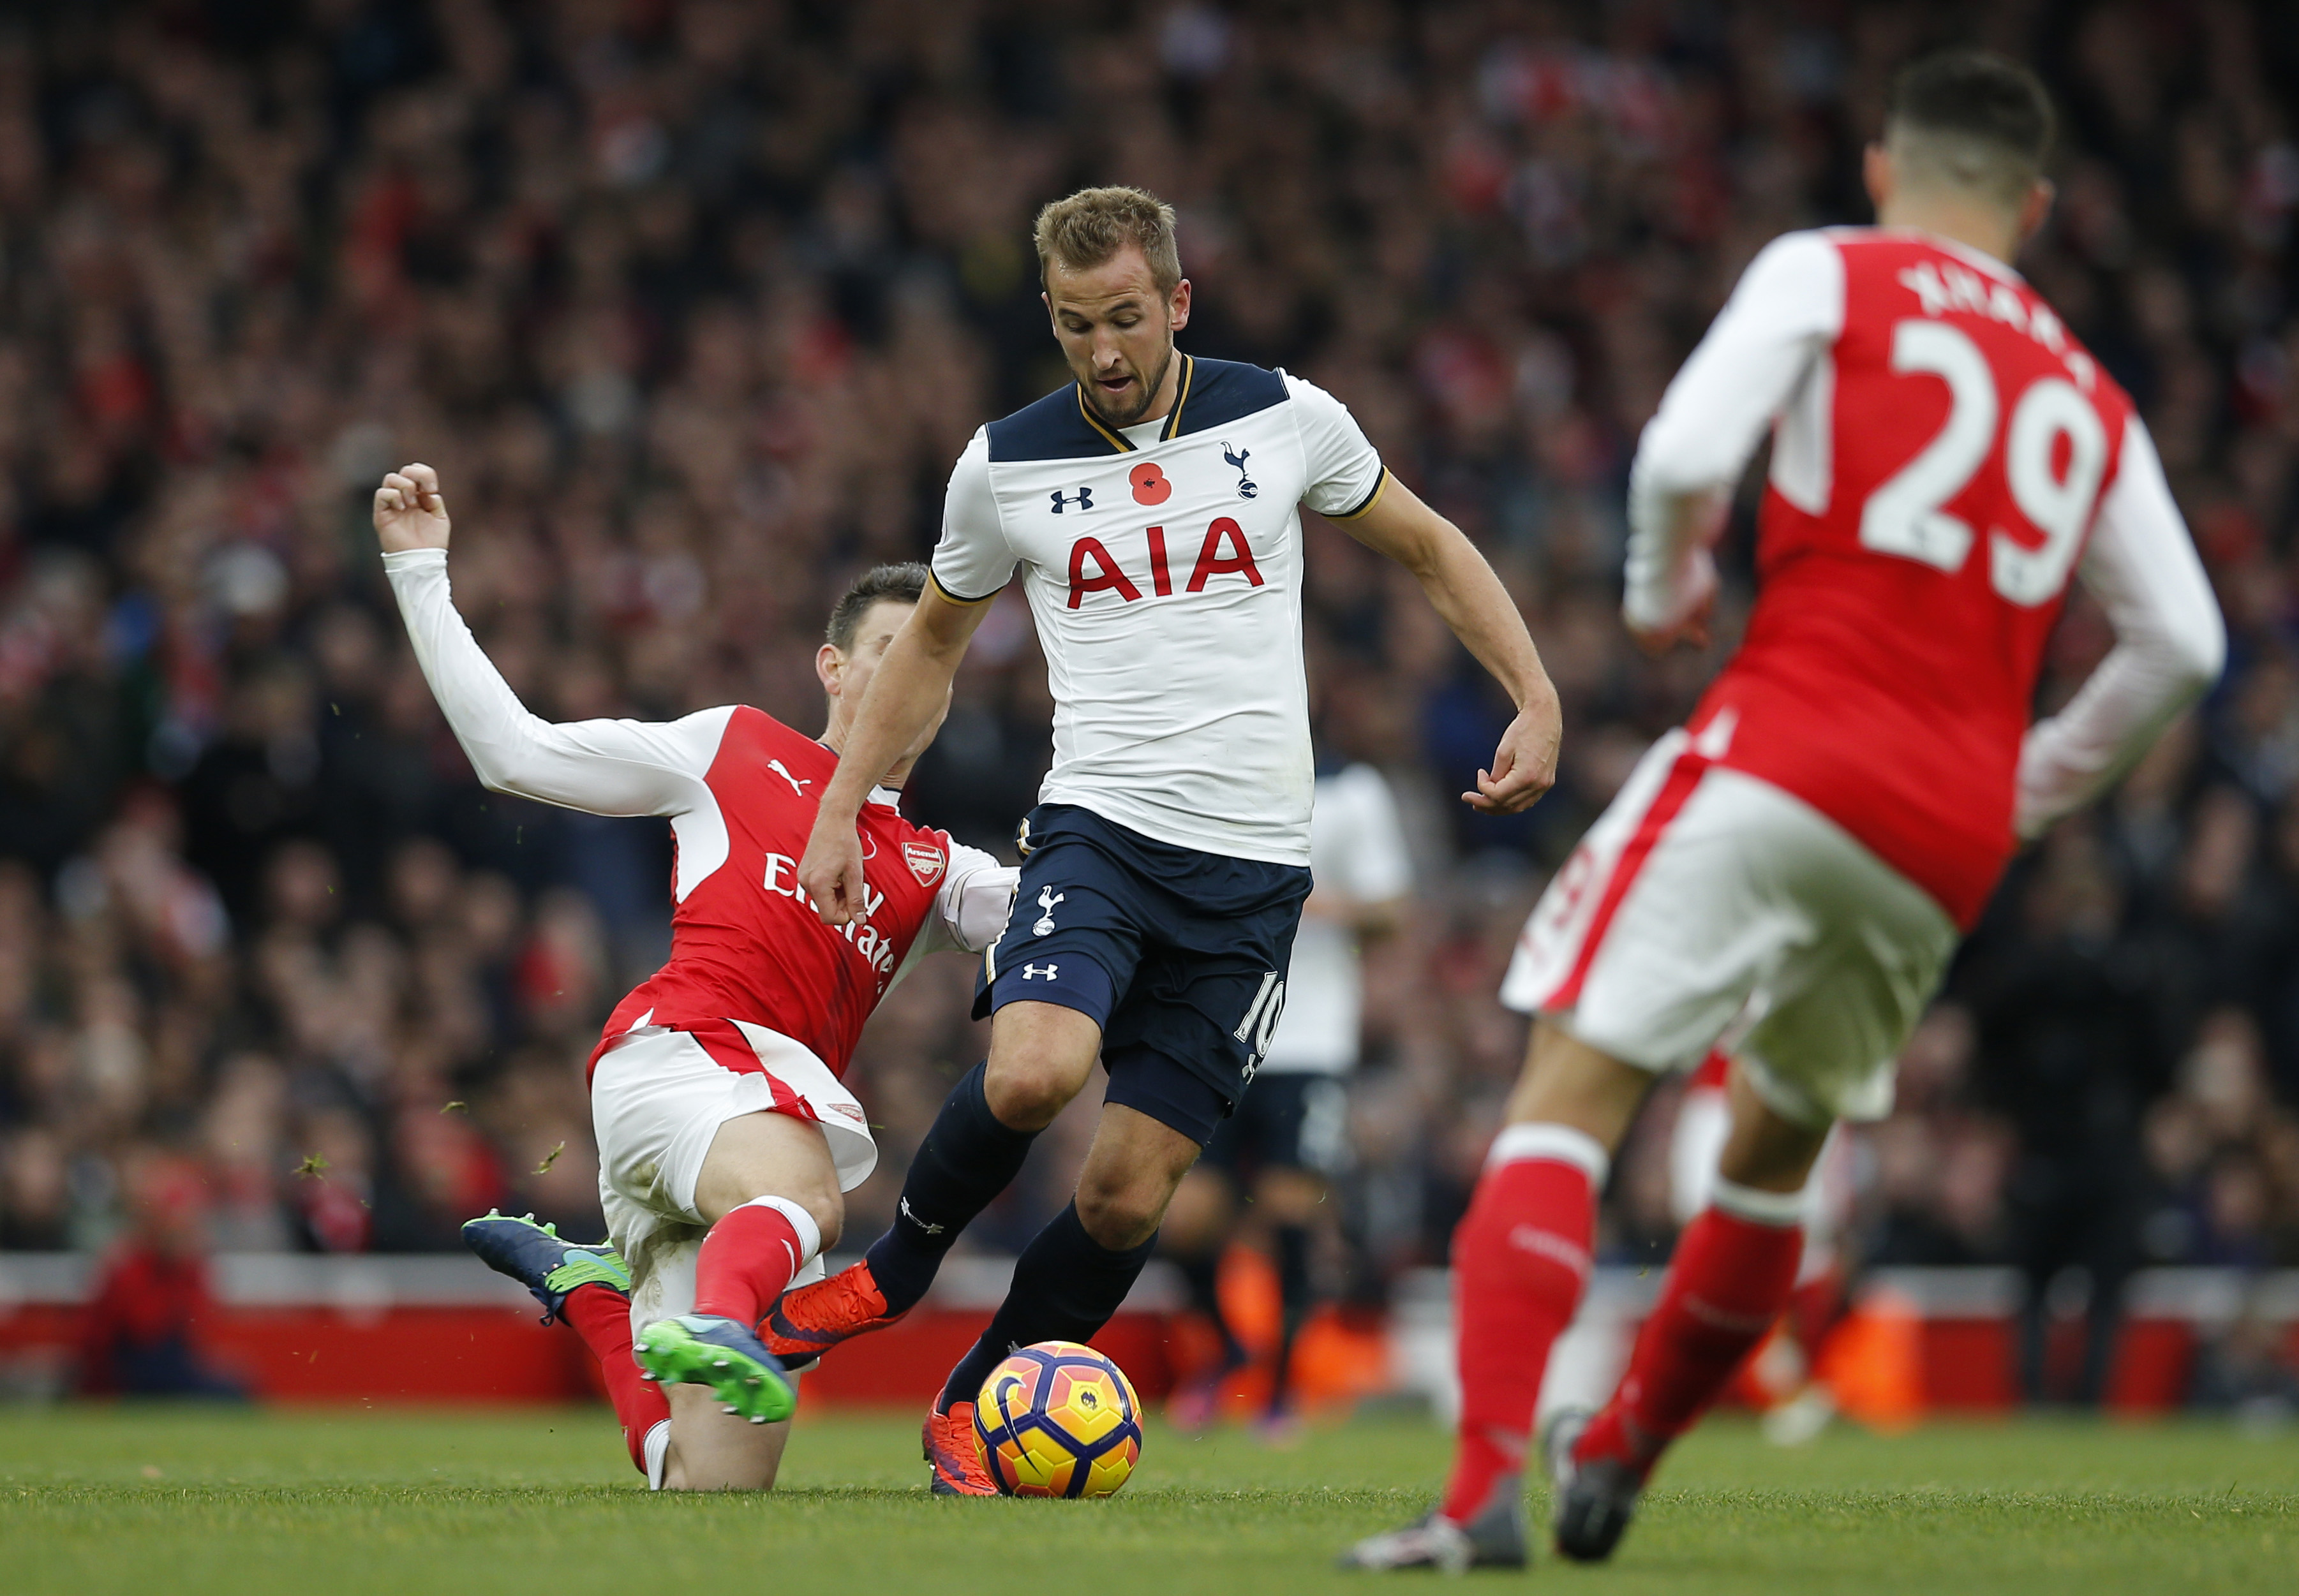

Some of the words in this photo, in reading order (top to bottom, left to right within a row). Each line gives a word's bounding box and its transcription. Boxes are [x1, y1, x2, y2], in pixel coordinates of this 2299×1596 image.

[1857, 316, 2108, 608] 29
[1067, 517, 1265, 610] AIA
[907, 847, 939, 859] Arsenal
[1233, 970, 1285, 1058] 10
